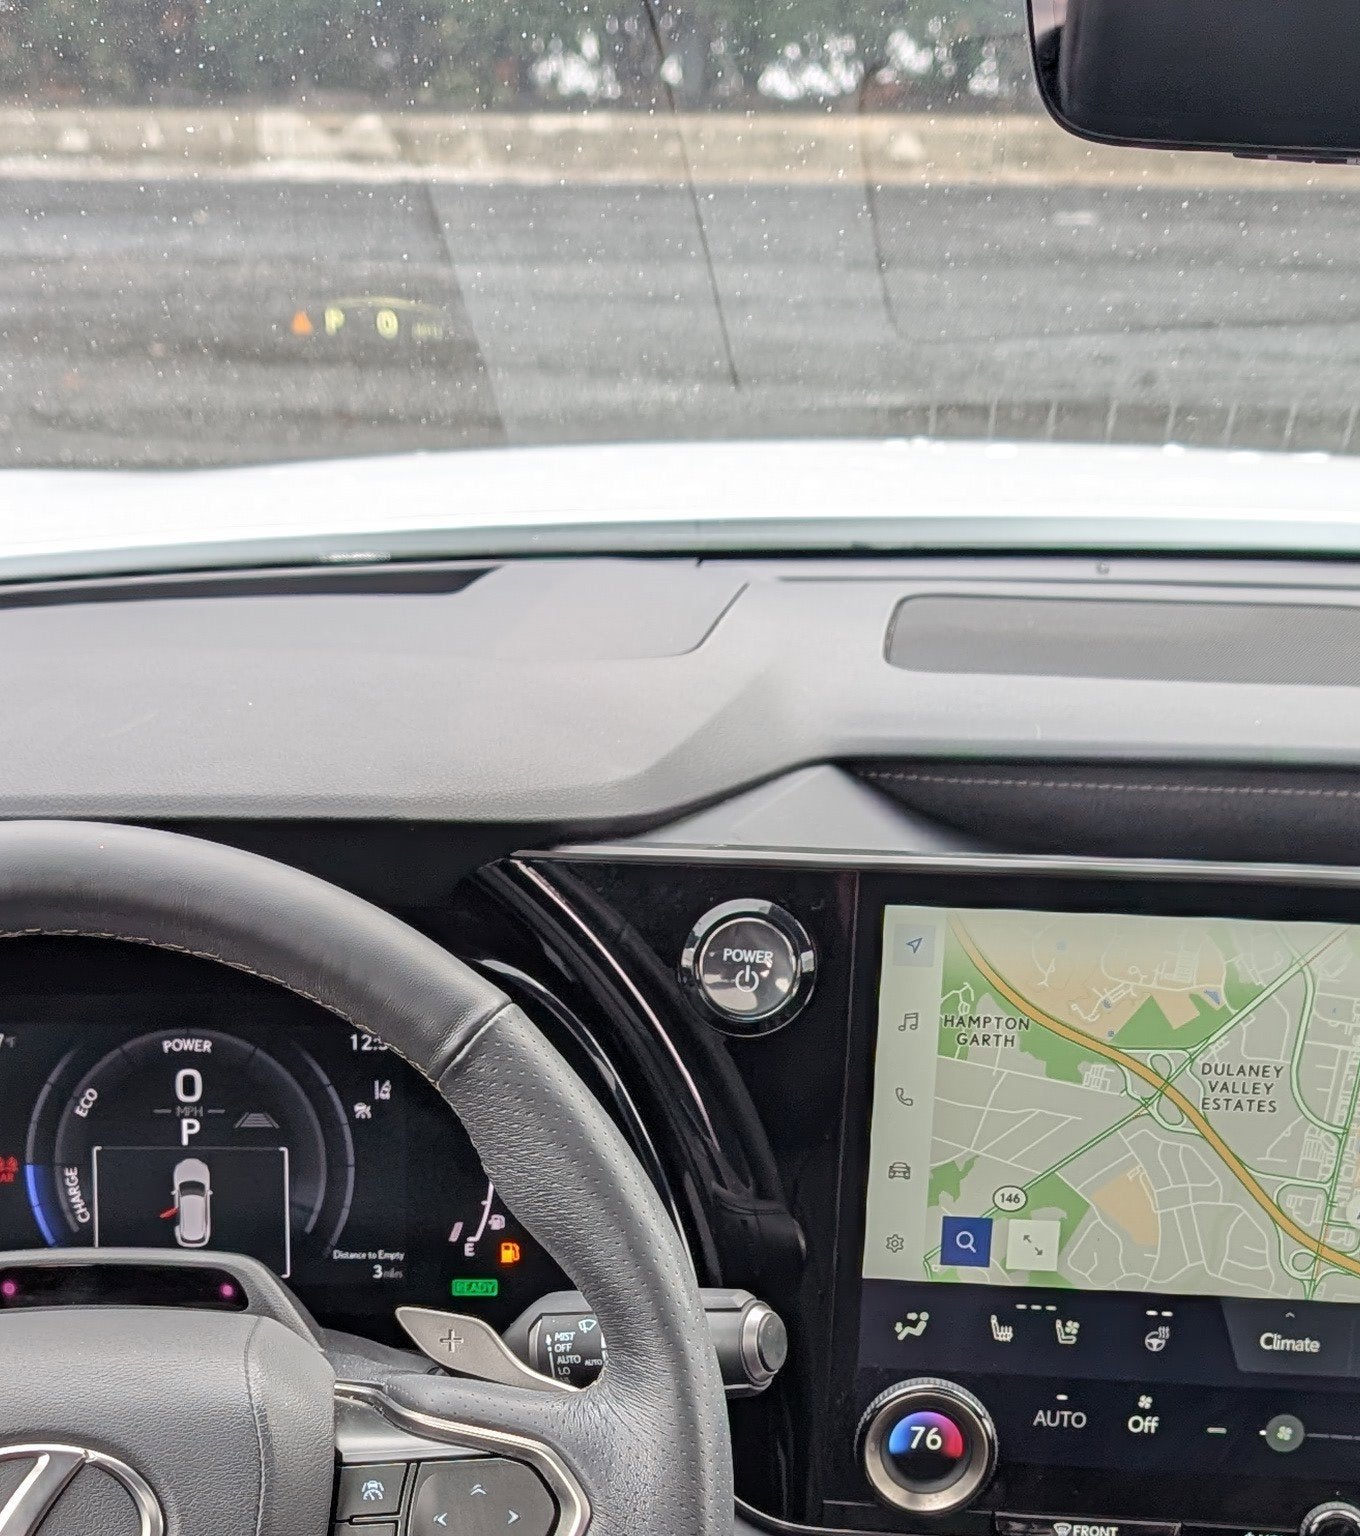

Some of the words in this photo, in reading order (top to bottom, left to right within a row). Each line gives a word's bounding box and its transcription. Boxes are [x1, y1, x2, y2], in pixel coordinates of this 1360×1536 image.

[723, 948, 773, 963] POWER
[943, 1014, 1030, 1032] HAMPTON
[162, 1038, 212, 1053] POWER
[956, 1032, 1015, 1049] GARTH
[1201, 1063, 1284, 1080] DULANEY
[175, 1068, 203, 1103] 0
[1208, 1080, 1274, 1097] VALLEY
[74, 1088, 98, 1118] ECO
[1201, 1098, 1277, 1114] ESTATES
[176, 1106, 204, 1117] MPH
[181, 1118, 200, 1146] P
[64, 1166, 91, 1224] CHARGE
[1000, 1193, 1021, 1205] 146
[333, 1250, 366, 1260] Distance
[367, 1251, 377, 1260] to
[378, 1250, 405, 1261] Empty
[464, 1243, 476, 1257] E
[373, 1264, 383, 1279] 3
[455, 1282, 497, 1294] READY
[554, 1332, 576, 1342] MIST
[1259, 1332, 1321, 1353] Climate
[554, 1343, 573, 1353] OFF
[557, 1355, 581, 1365] AUTO
[558, 1367, 571, 1375] LO
[1033, 1410, 1087, 1429] AUTO
[1127, 1415, 1159, 1435] Off
[910, 1427, 942, 1451] 76
